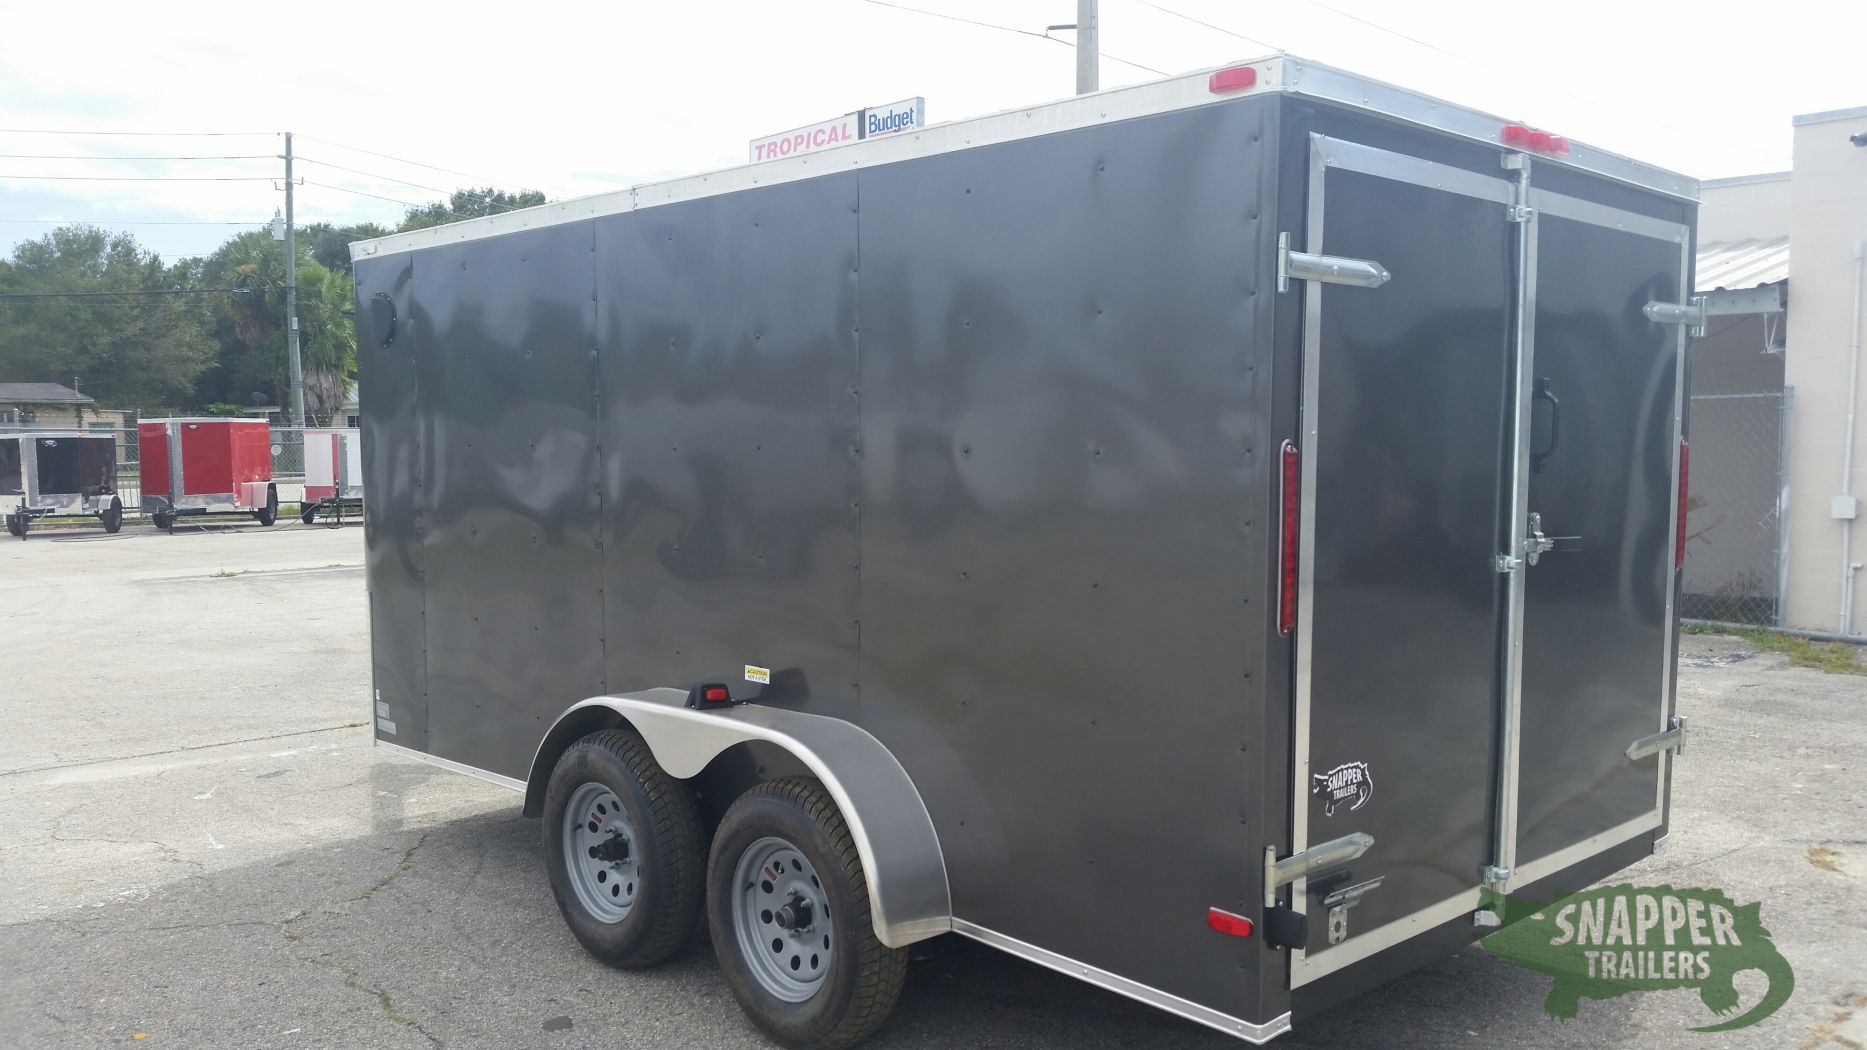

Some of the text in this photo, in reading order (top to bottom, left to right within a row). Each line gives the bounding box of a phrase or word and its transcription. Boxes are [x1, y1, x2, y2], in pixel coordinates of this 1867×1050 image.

[868, 107, 915, 134] Budget
[755, 123, 852, 161] TROPICAL
[1327, 768, 1362, 792] SNAPPER
[1333, 784, 1357, 800] TRAILERS
